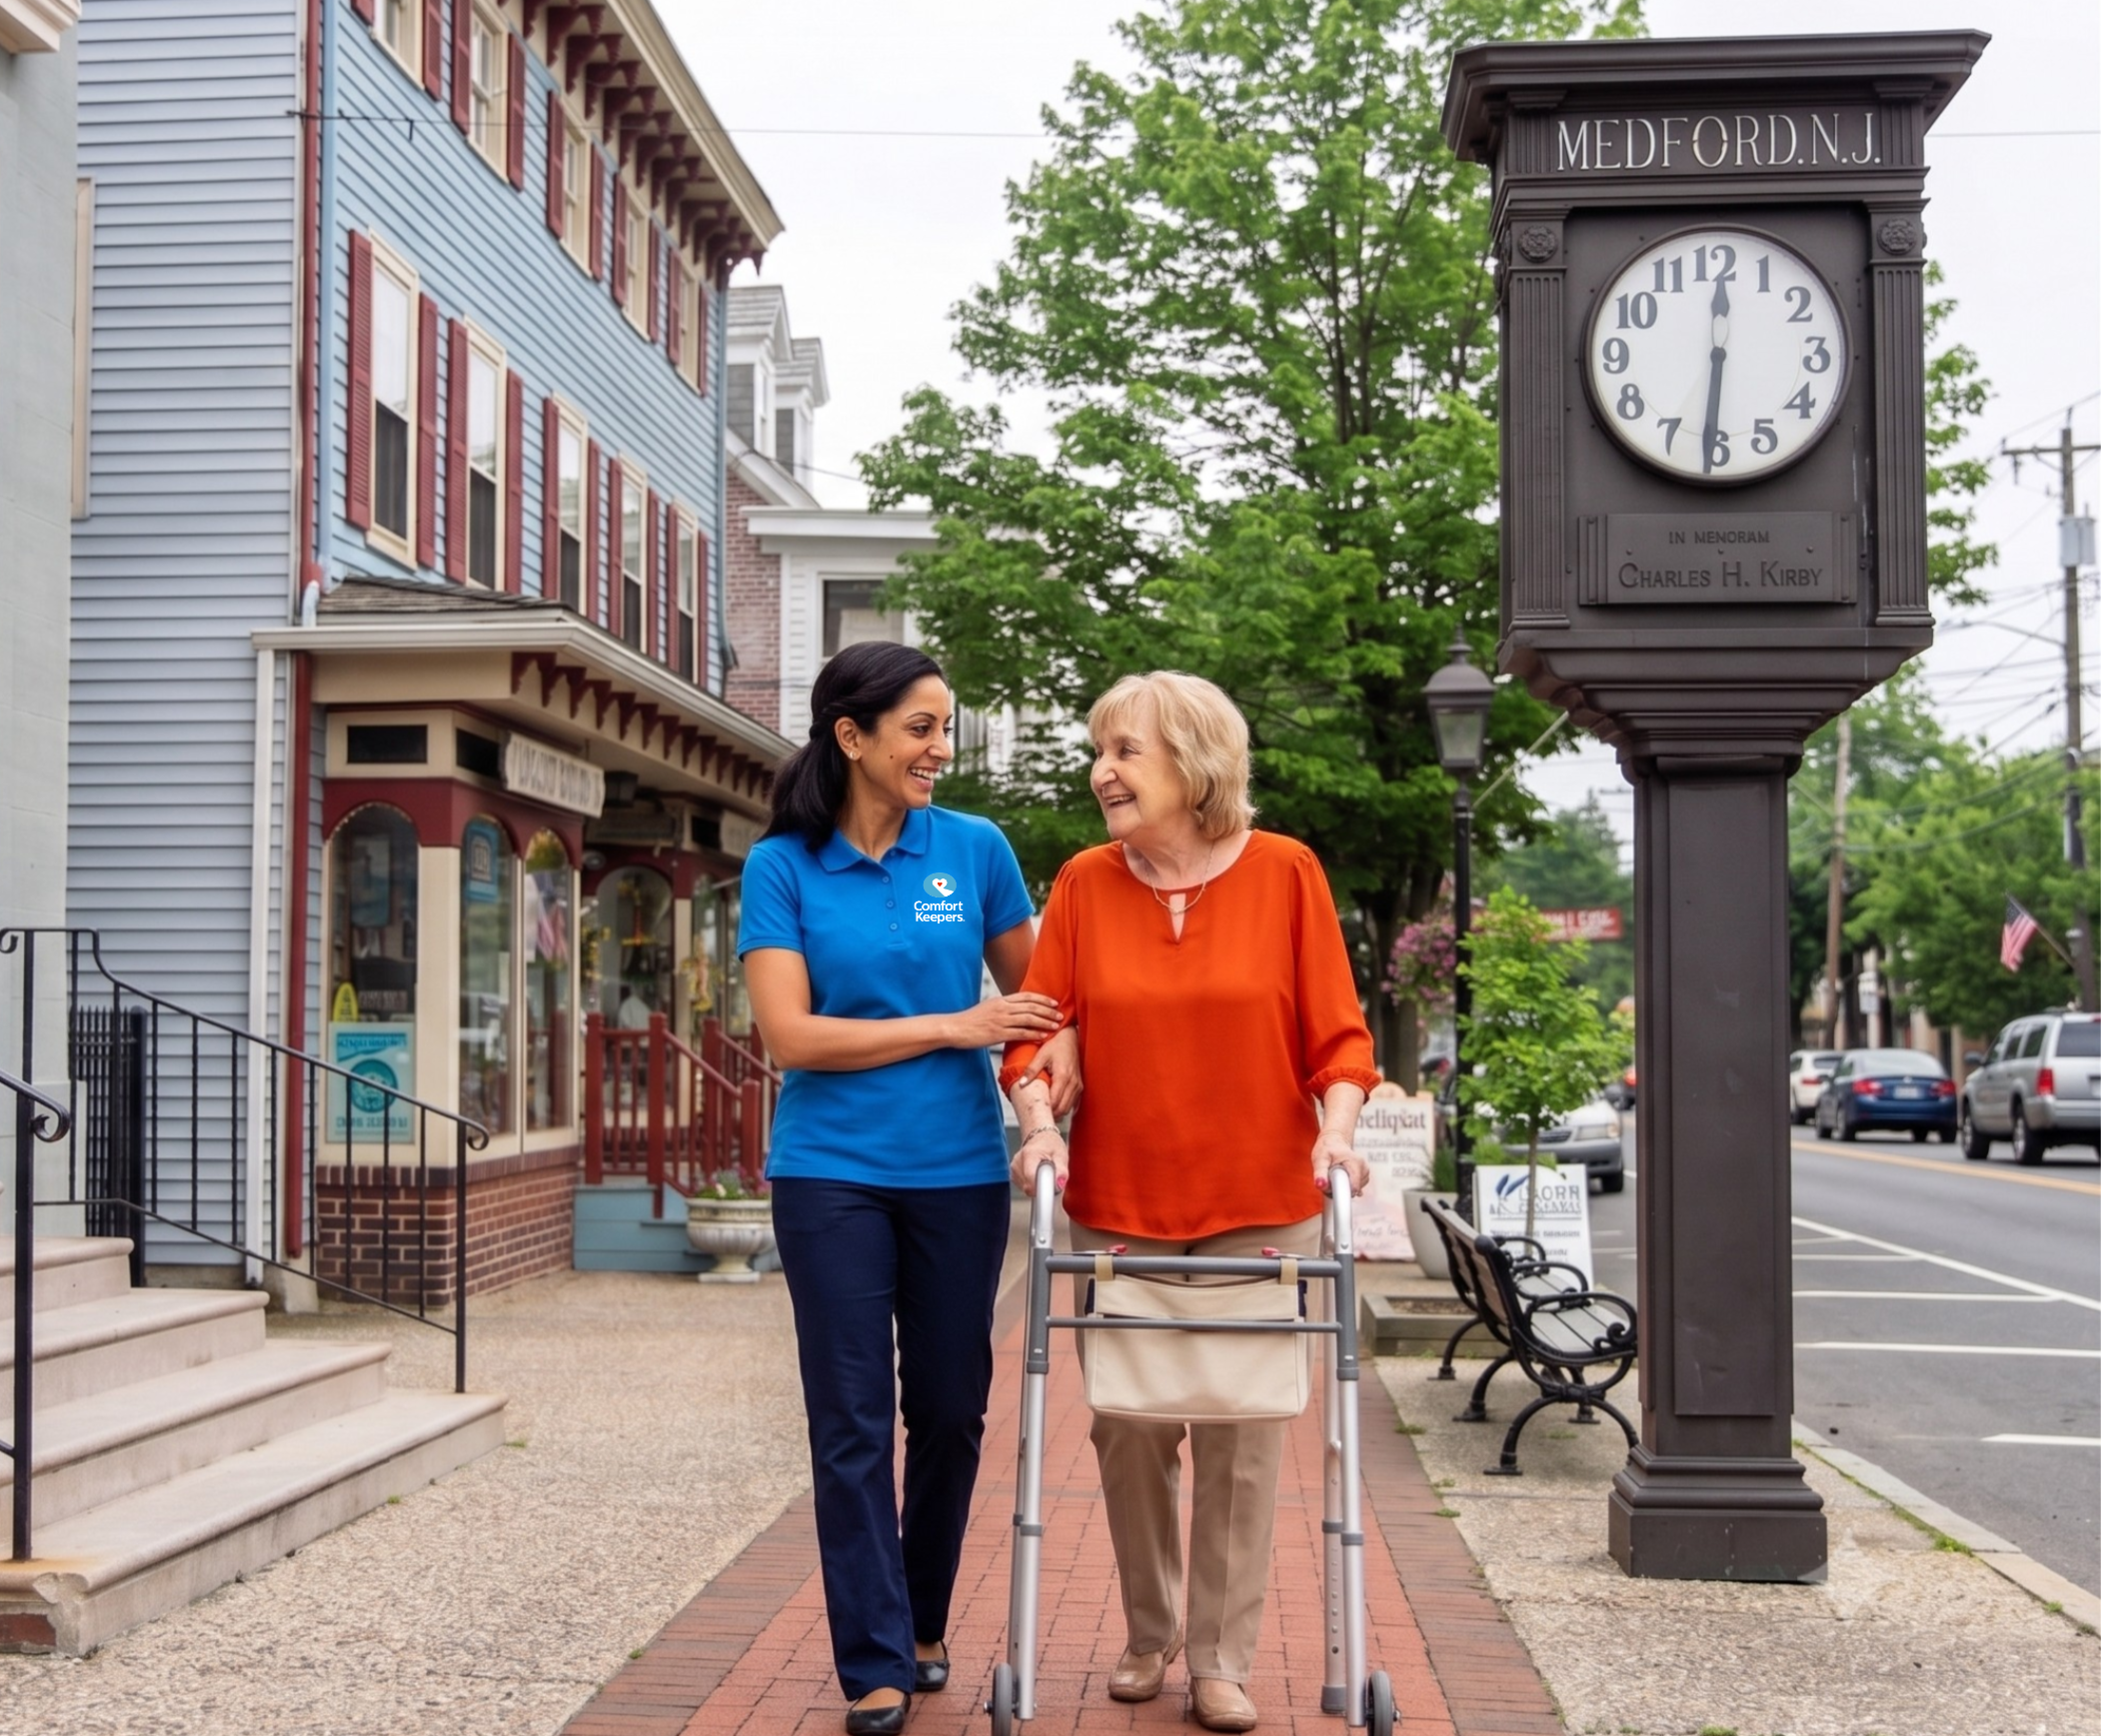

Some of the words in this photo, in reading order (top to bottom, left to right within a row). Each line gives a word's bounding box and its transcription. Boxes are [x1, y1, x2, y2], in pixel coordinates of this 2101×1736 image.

[1651, 256, 1684, 293] 11
[1693, 245, 1737, 282] 12
[1756, 255, 1771, 293] 1
[1615, 291, 1658, 329] 10
[1783, 286, 1813, 323] 2
[1601, 337, 1629, 374] 9
[1802, 336, 1831, 374] 3
[1616, 383, 1645, 420] 8
[1782, 381, 1816, 419] 4
[1656, 417, 1682, 456] 7
[1708, 429, 1730, 467] 6
[1750, 418, 1778, 454] 5
[1669, 531, 1685, 544] IN
[1618, 563, 1711, 589] CHARLES
[1721, 561, 1749, 588] H.
[1760, 561, 1823, 587] KIRBY
[914, 900, 964, 911] Comfort
